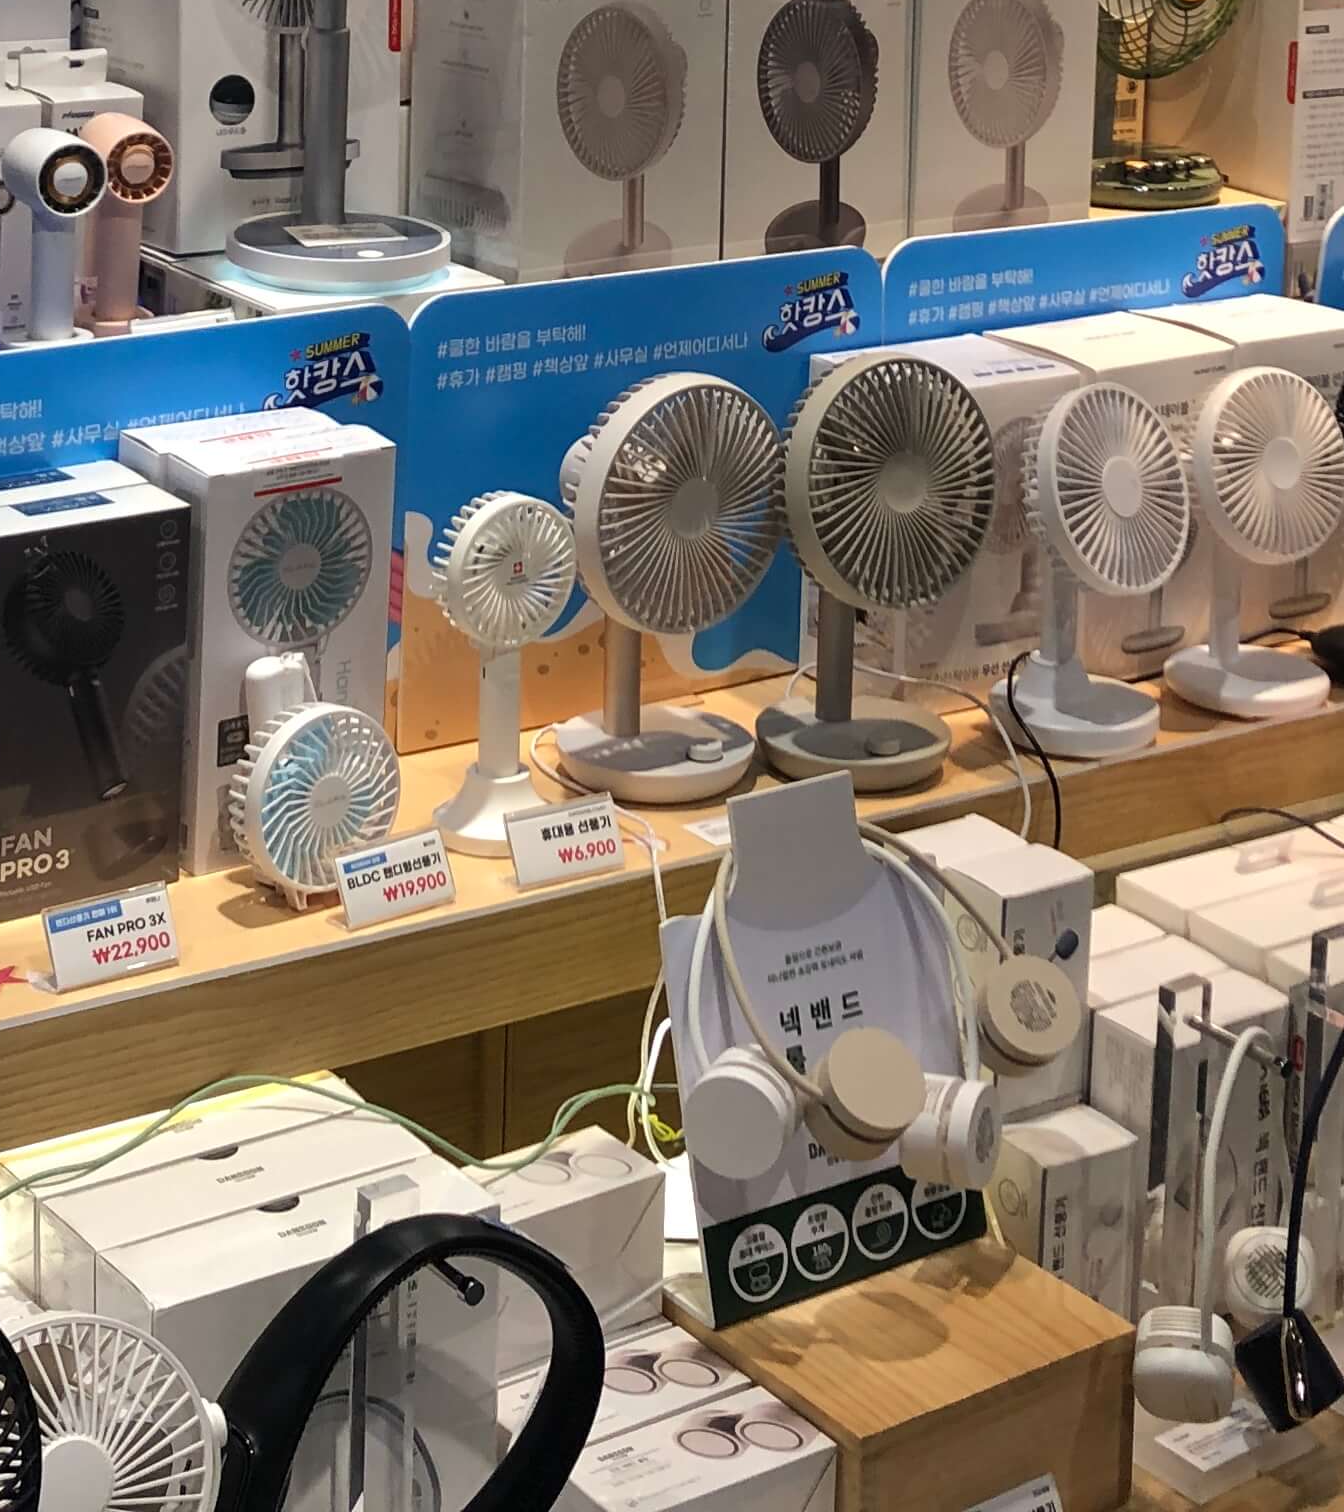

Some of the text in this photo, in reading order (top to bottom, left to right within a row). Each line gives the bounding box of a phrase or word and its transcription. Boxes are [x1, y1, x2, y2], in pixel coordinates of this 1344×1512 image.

[1196, 241, 1254, 278] 핫캉스
[795, 272, 842, 296] SUMMER
[779, 288, 848, 334] 핫캉스
[305, 332, 361, 361] SUMMER
[437, 324, 588, 360] #쿨한 바람을 부탁해!
[436, 330, 749, 391] #휴가 #캠핑 #책상앞 #사무실 #언제어디서나
[284, 356, 371, 404] 핫캉스
[51, 419, 122, 448] #사무실
[1, 827, 52, 857] FAN
[540, 814, 612, 842] 휴대용 선풍기
[558, 838, 617, 864] ₩6,900
[0, 853, 53, 883] PRO
[346, 870, 381, 890] BLDC
[383, 870, 447, 903] ₩19,900
[86, 911, 167, 943] FAN PRO 3X
[92, 931, 171, 966] ₩22,900
